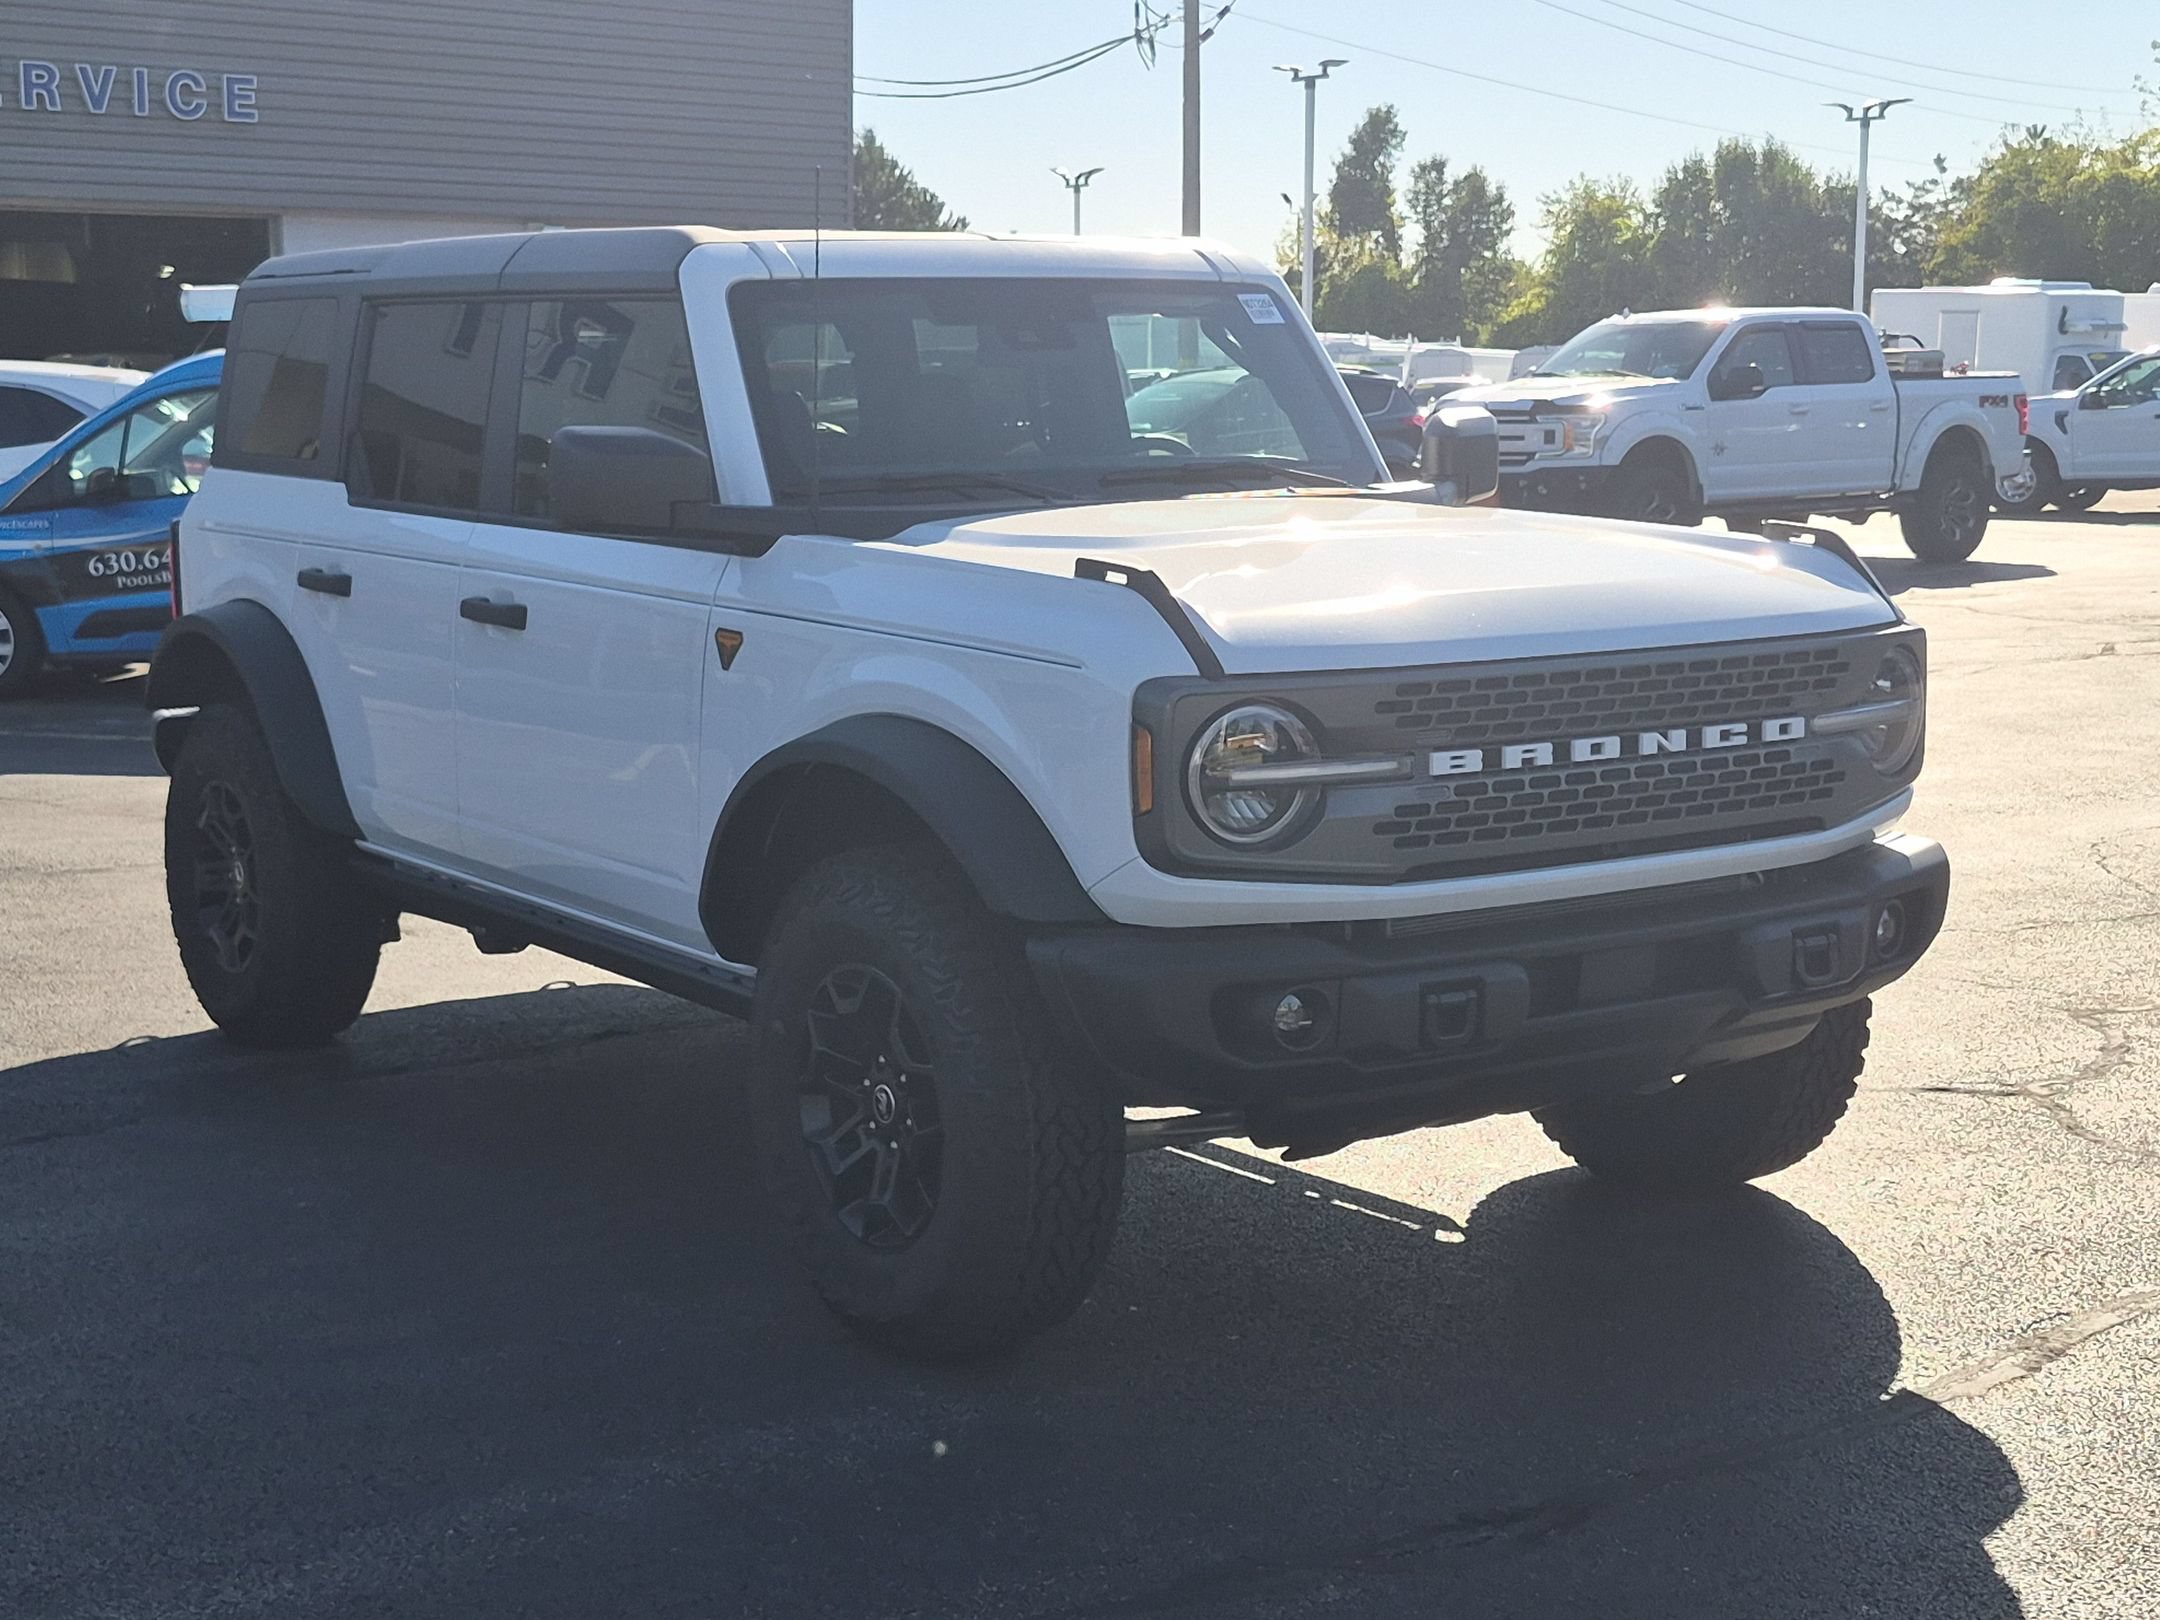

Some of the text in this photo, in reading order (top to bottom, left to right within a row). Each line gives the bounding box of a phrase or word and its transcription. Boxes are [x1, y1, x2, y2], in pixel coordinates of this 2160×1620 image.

[0, 60, 258, 123] RVICE
[1979, 394, 2008, 408] FX4
[1429, 716, 1805, 776] BRONCO
